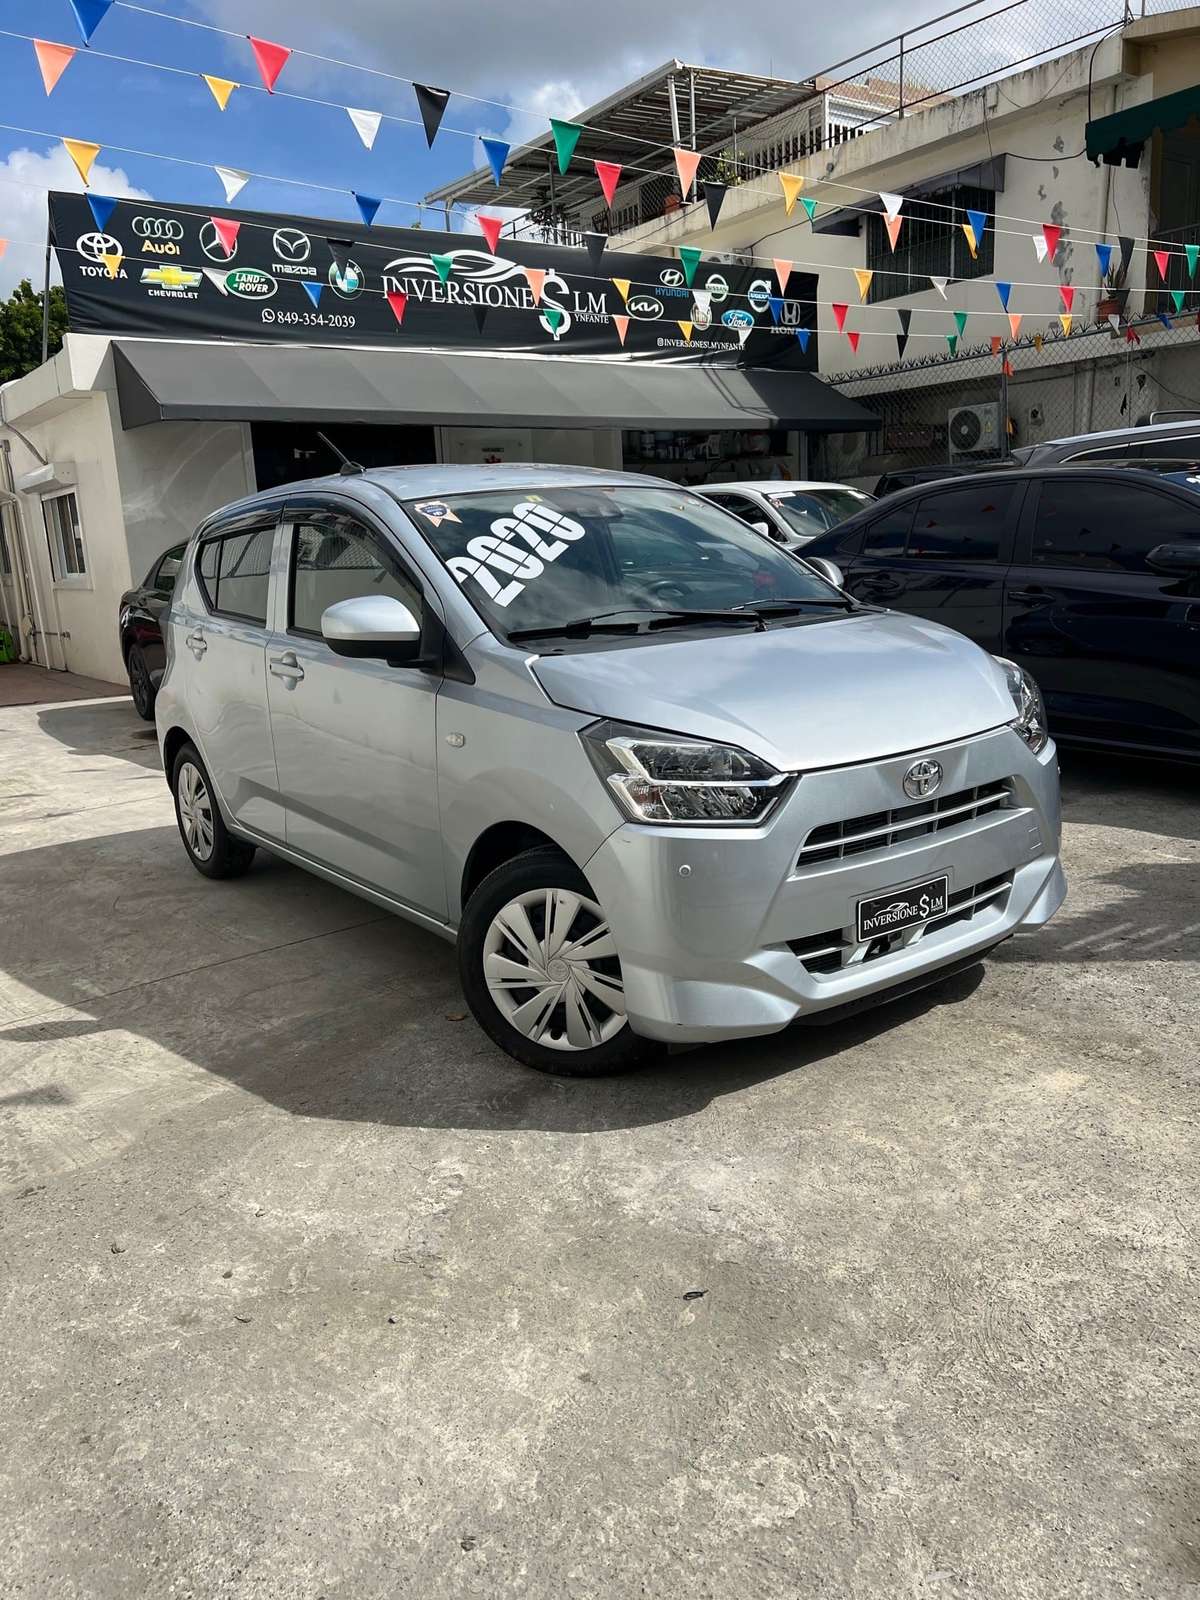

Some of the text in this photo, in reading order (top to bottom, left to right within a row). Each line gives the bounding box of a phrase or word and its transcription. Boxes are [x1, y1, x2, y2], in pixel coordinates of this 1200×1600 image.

[142, 240, 180, 255] Audi
[79, 266, 128, 279] TOYOTA
[235, 272, 259, 283] LAND
[148, 289, 198, 299] CHEVROLET
[238, 282, 269, 293] ROVER
[655, 287, 690, 298] HYUNDAI
[573, 290, 607, 314] LM
[277, 311, 356, 328] 849-354-2039
[574, 313, 610, 324] YNFANTE
[728, 312, 748, 327] Ford
[444, 502, 586, 608] 2020
